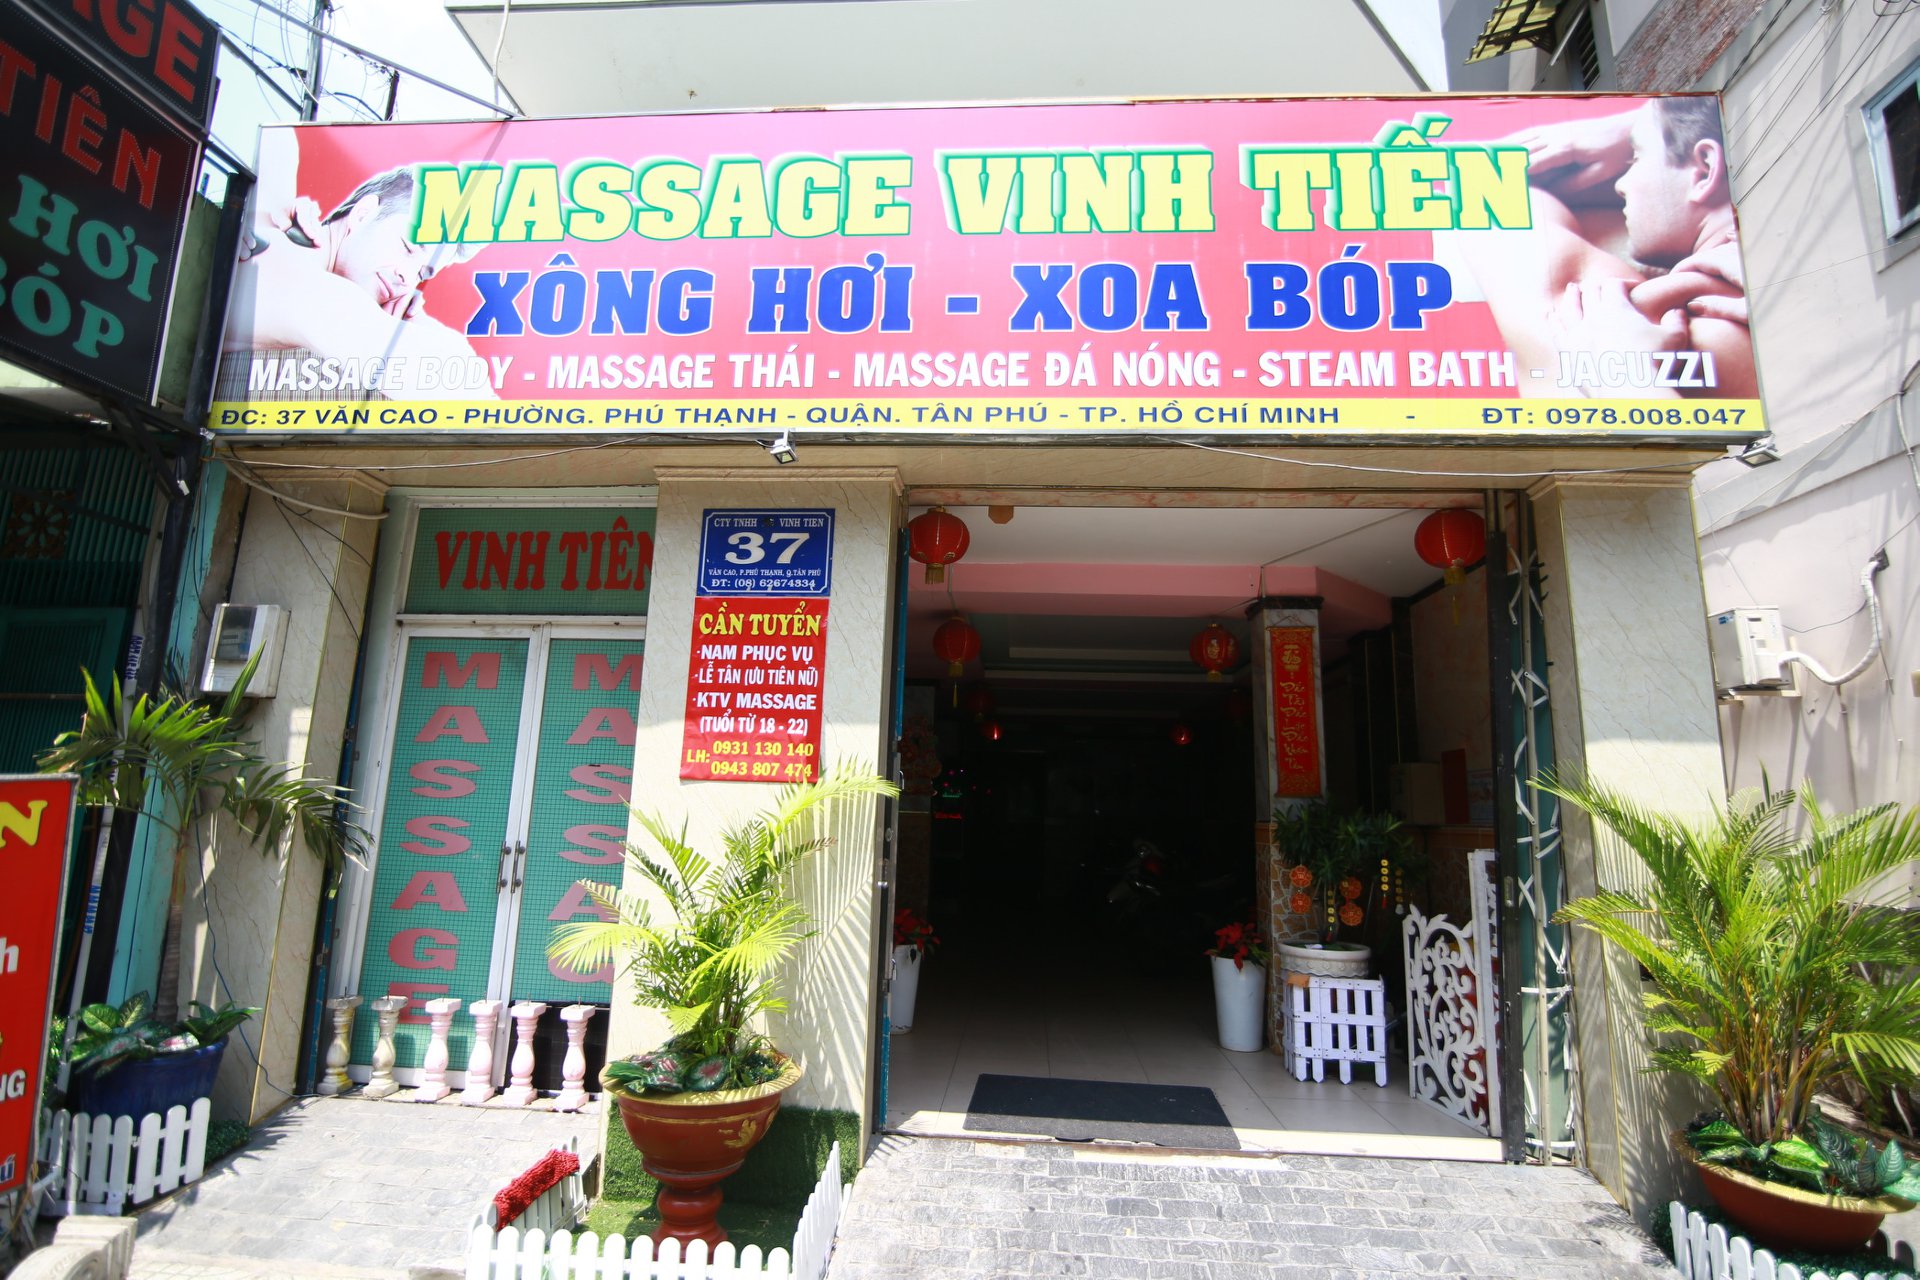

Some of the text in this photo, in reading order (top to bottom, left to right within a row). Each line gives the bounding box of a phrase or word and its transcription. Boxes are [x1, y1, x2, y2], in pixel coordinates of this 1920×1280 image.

[411, 112, 1533, 243] MASSAGE VINH TIẾN
[8, 173, 158, 302] HƠI
[466, 252, 715, 336] XÔNG
[747, 252, 913, 333] HƠI
[1009, 262, 1210, 332] XOA
[1245, 244, 1453, 332] BÓP
[0, 256, 124, 358] ÓP
[248, 357, 407, 391] MASSAGE
[416, 356, 513, 391] BODY
[548, 354, 715, 389] MASSAGE
[729, 344, 815, 388] THÁI
[852, 352, 1029, 388] MASSAGE
[1044, 342, 1097, 387] ĐÁ
[1112, 342, 1220, 387] NÓNG
[1258, 351, 1396, 387] STEAM
[1409, 351, 1517, 387] BATH
[1556, 351, 1718, 388] JACUZZI
[221, 410, 267, 425] ĐC:
[276, 410, 306, 425] 37
[315, 404, 371, 425] VĂN
[379, 409, 438, 424] CAO
[464, 405, 594, 424] PHƯỜNG.
[605, 404, 664, 424] PHÚ
[675, 408, 777, 427] THẠNH
[806, 403, 901, 426] QUẬN.
[912, 403, 972, 423] TÂN
[985, 402, 1048, 423] PHÚ
[1079, 406, 1126, 423] TP.
[1138, 400, 1183, 423] HỒ
[1194, 402, 1248, 423] CHÍ
[1260, 407, 1339, 423] MINH
[1482, 408, 1534, 424] ĐT:
[1546, 408, 1746, 426] 0978.008.047
[714, 518, 731, 527] CTY
[734, 518, 757, 527] TNHH
[779, 518, 800, 527] VINH
[436, 531, 550, 591] VINH
[724, 532, 810, 565] 37
[712, 578, 731, 588] ĐT:
[734, 578, 756, 588] (08)
[699, 601, 821, 636] CẦN TUYỂN
[700, 644, 813, 665] NAM PHỤC VỤ
[698, 661, 714, 684] LỄ
[718, 664, 741, 684] TÂN
[768, 665, 795, 685] TIÊN
[798, 667, 818, 687] NỮ)
[697, 691, 817, 710] KTV MASSAGE
[701, 708, 735, 733] (TUỔI
[738, 713, 756, 734] TỪ
[760, 717, 775, 733] 18
[787, 718, 808, 737] 22)
[686, 749, 710, 763] LH:
[713, 740, 814, 756] 0931 130 140
[711, 761, 748, 775] 0943
[752, 762, 780, 776] 807
